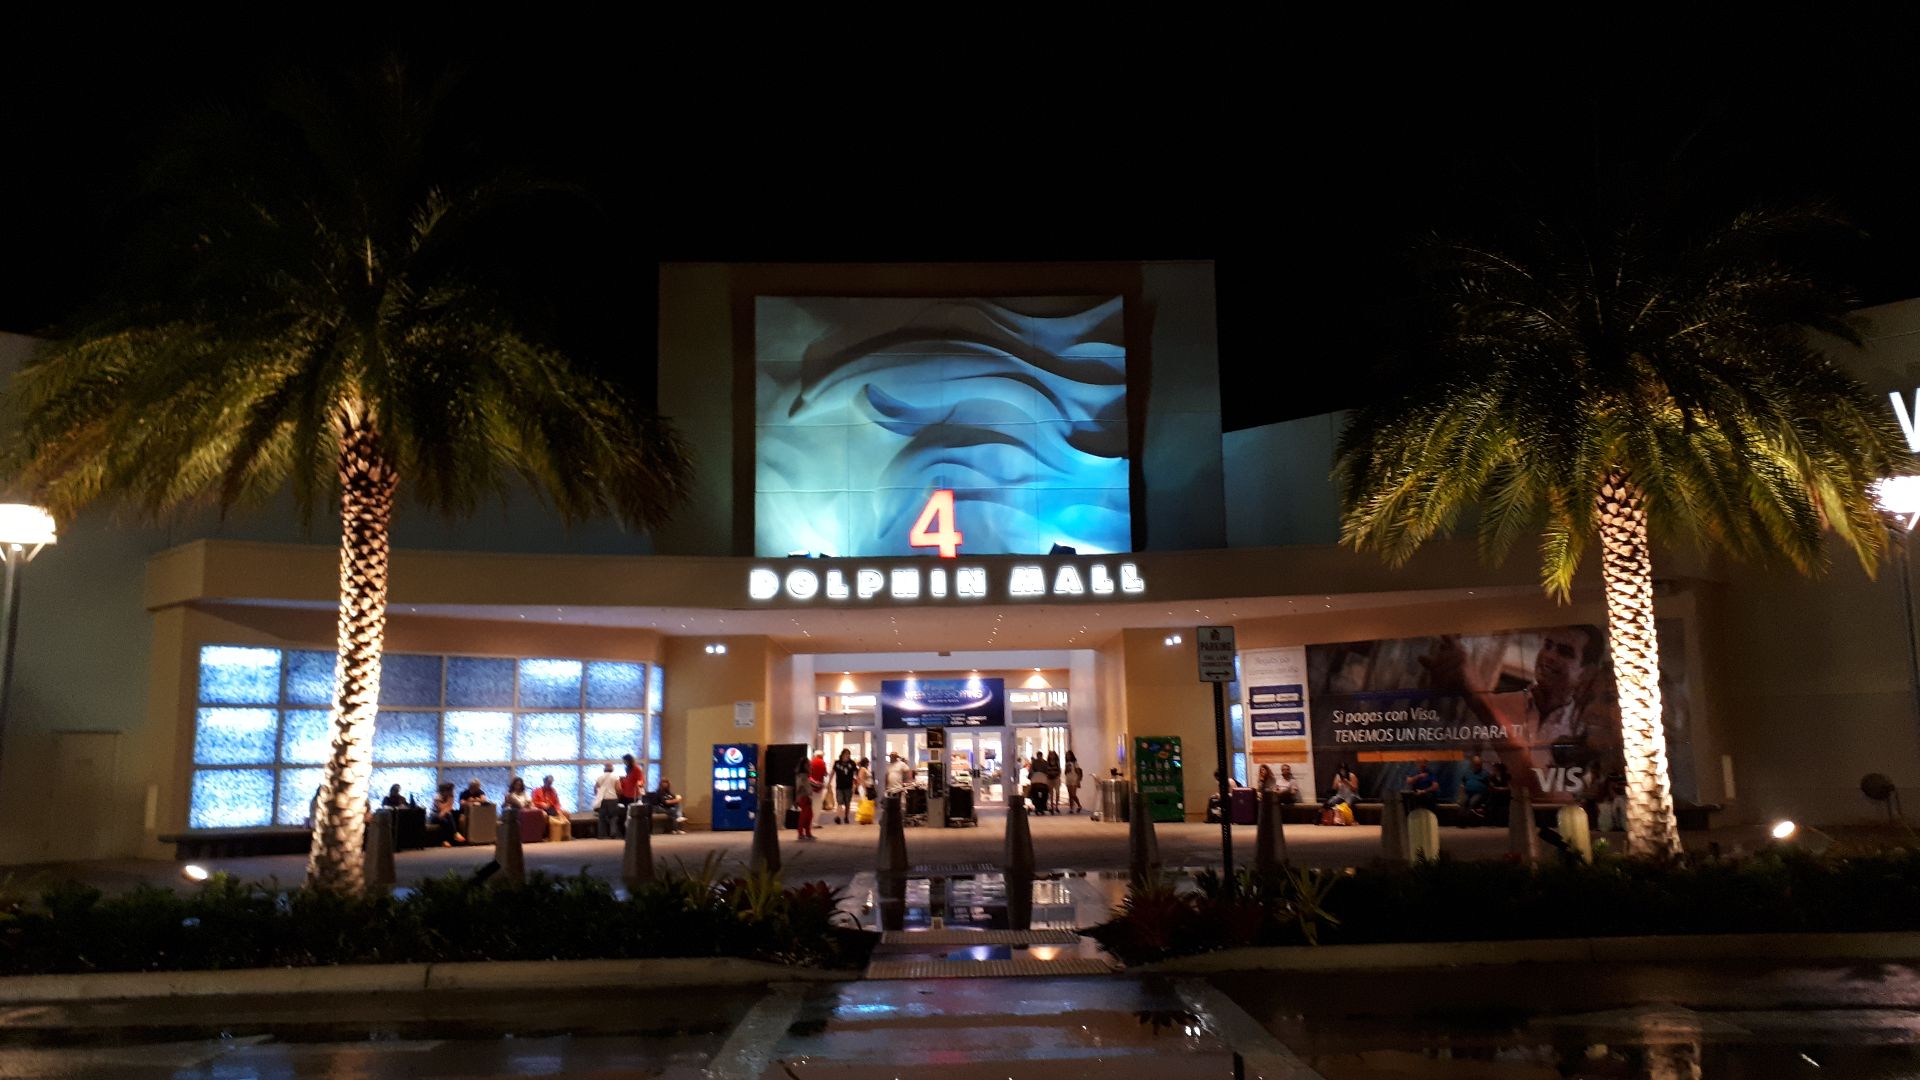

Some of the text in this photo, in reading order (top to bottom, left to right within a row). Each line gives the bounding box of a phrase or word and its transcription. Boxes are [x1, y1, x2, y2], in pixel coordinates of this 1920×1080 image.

[909, 488, 963, 559] 4
[749, 562, 1145, 599] DOLPHIN MALL
[1332, 710, 1344, 723] Si
[1345, 709, 1383, 726] pagas
[1385, 709, 1408, 722] con
[1334, 728, 1395, 743] TENEMOS
[1396, 727, 1418, 741] UN
[1420, 725, 1472, 741] REGALO
[1473, 724, 1508, 738] PARA
[1529, 766, 1586, 793] VIS
